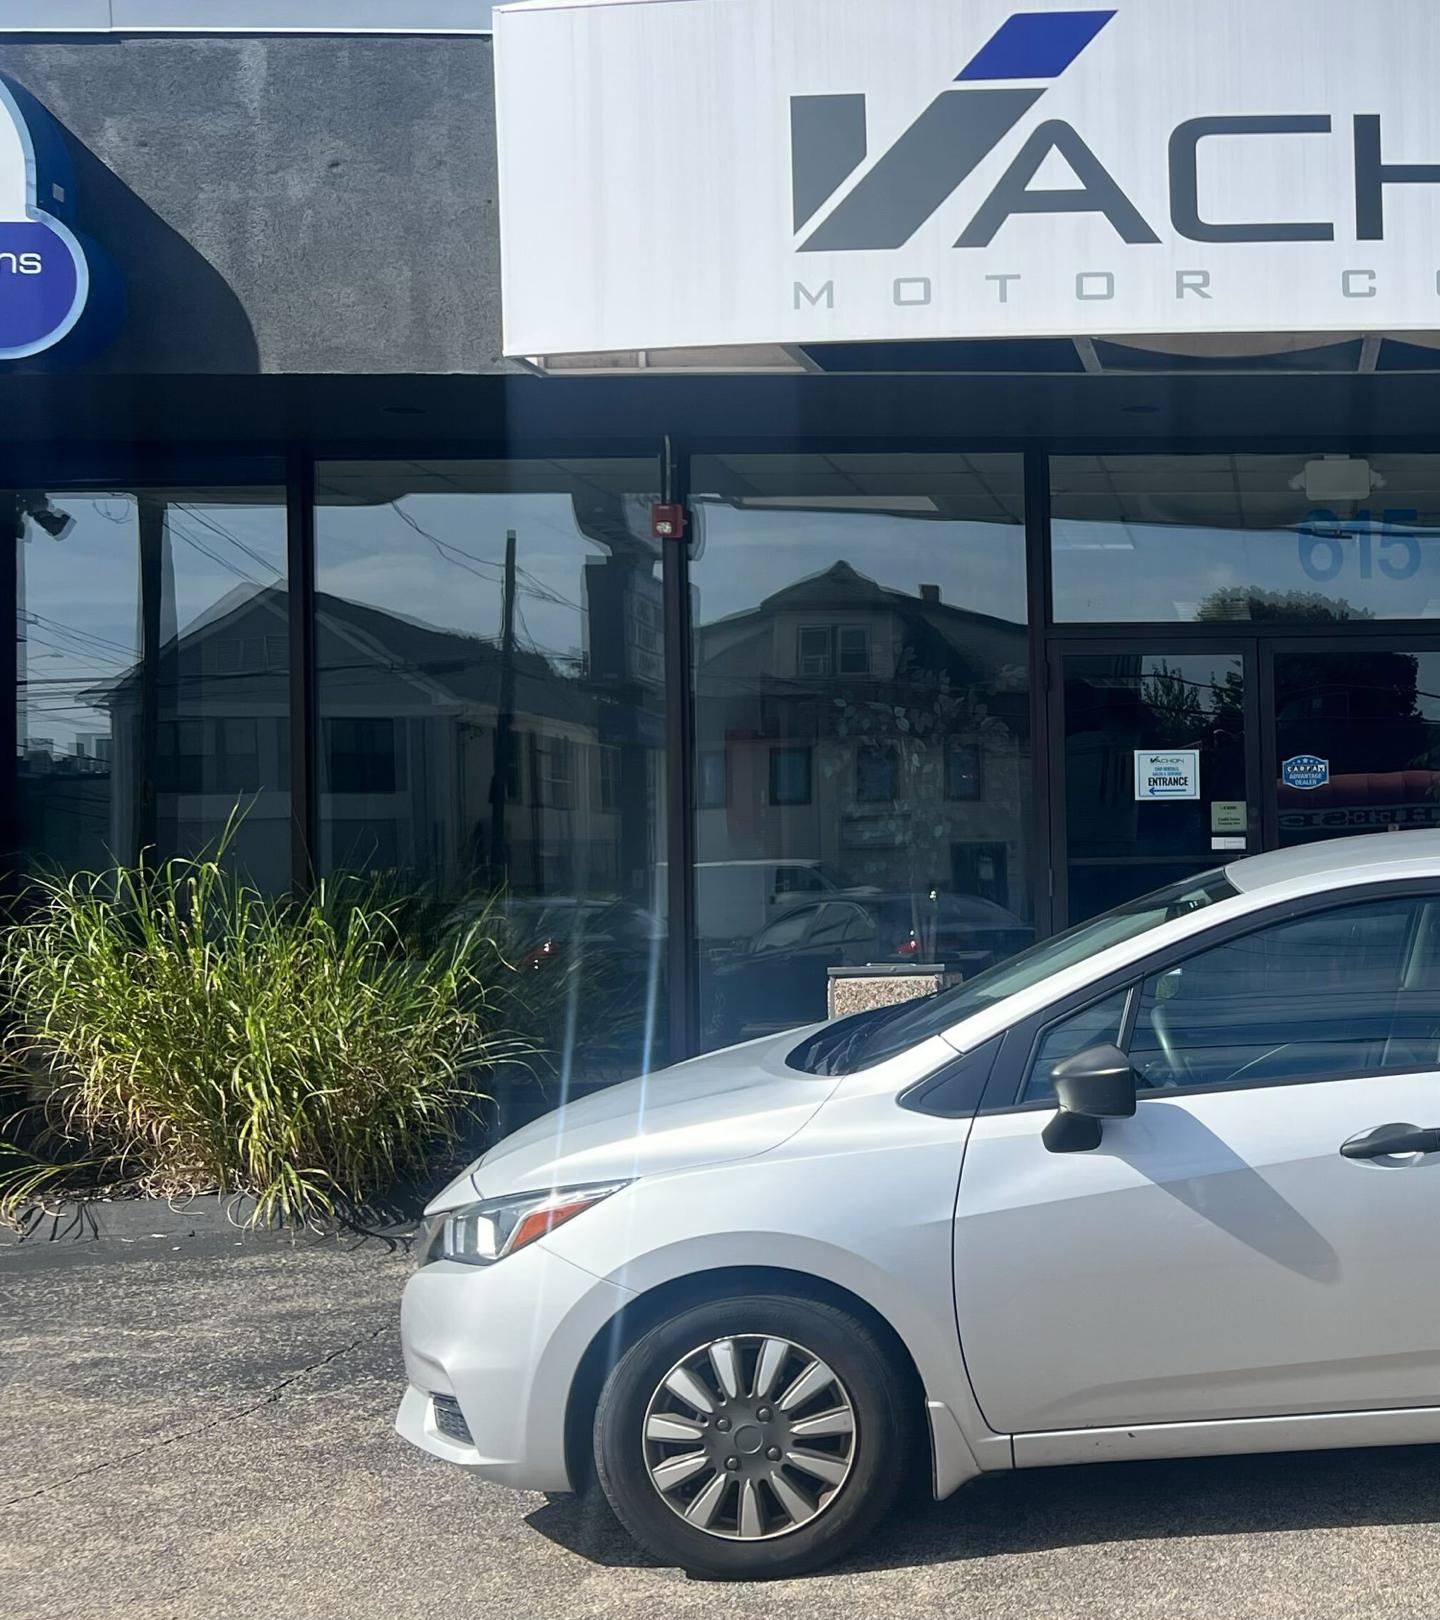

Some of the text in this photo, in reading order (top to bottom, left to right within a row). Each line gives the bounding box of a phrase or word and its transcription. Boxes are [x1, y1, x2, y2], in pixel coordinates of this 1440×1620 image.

[793, 270, 1213, 311] MOTOR
[1298, 508, 1422, 582] 615
[1148, 776, 1189, 787] ENTRANCE
